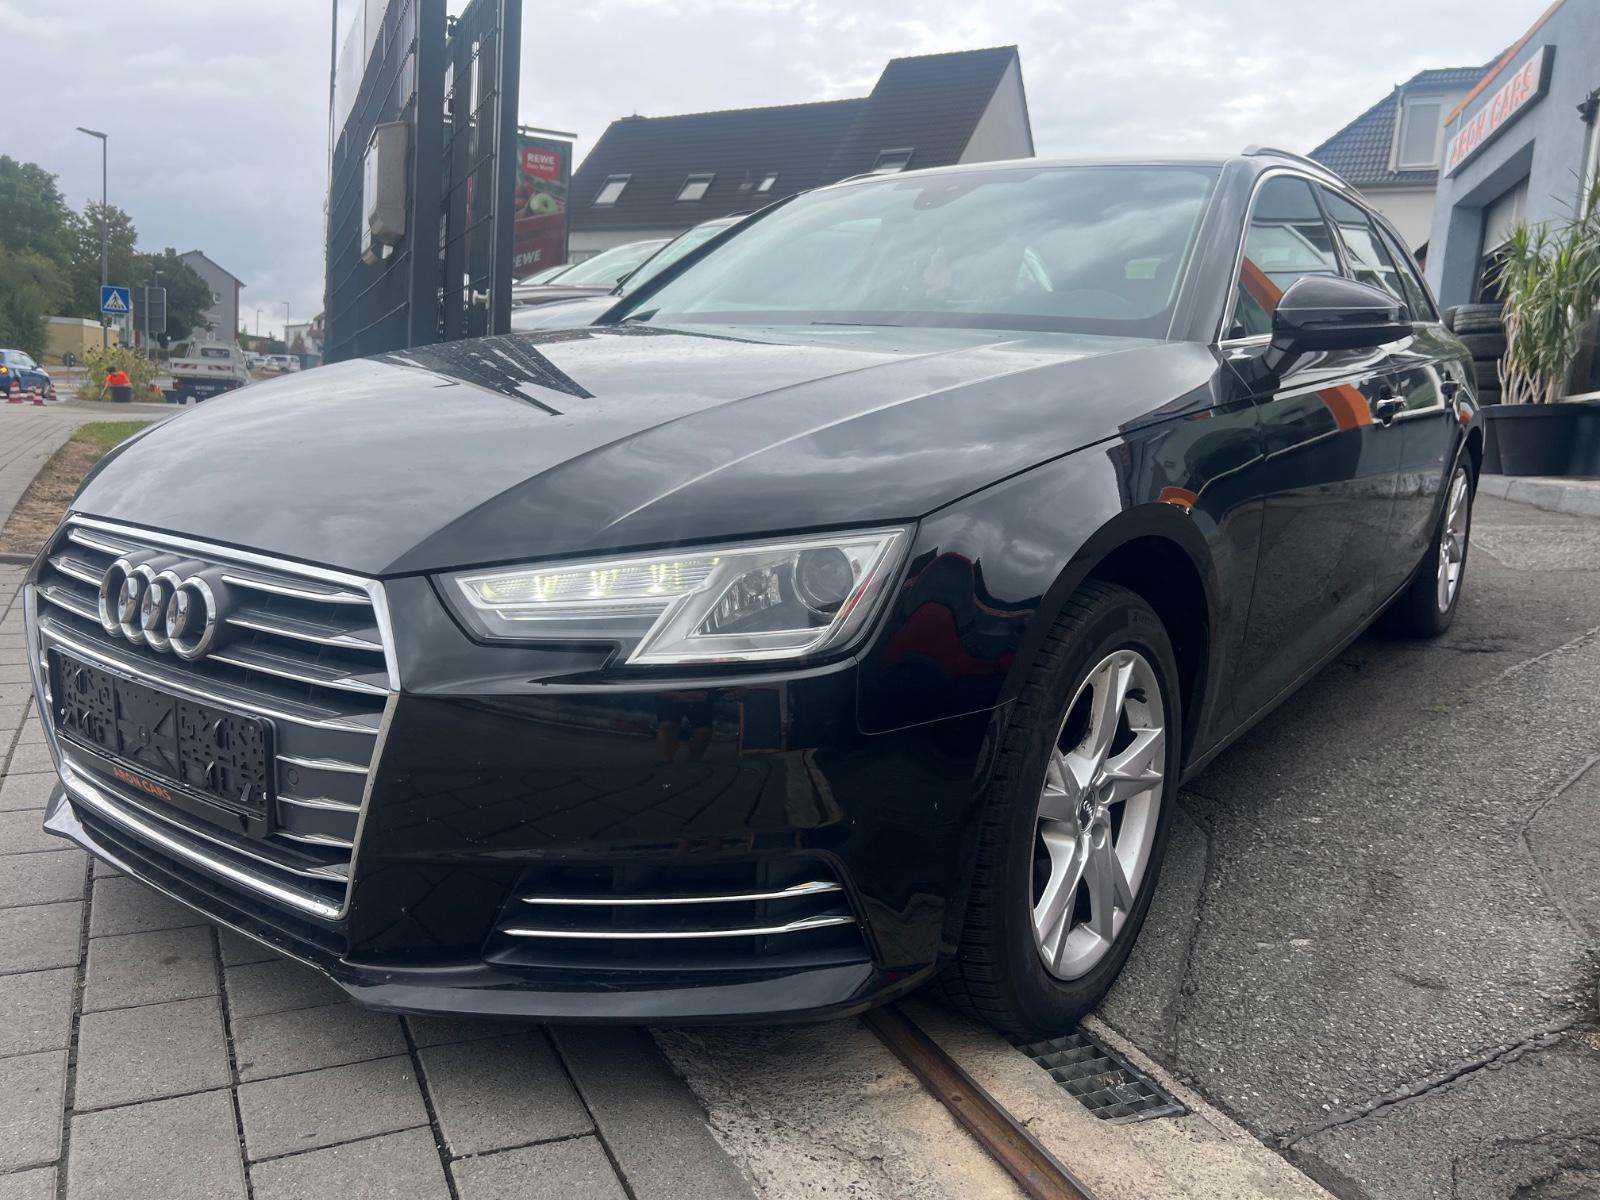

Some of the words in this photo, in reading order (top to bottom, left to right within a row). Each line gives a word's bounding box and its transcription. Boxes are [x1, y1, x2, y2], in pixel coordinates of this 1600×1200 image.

[1490, 62, 1534, 129] CARS
[527, 153, 555, 165] REWE
[142, 780, 172, 801] CARS
